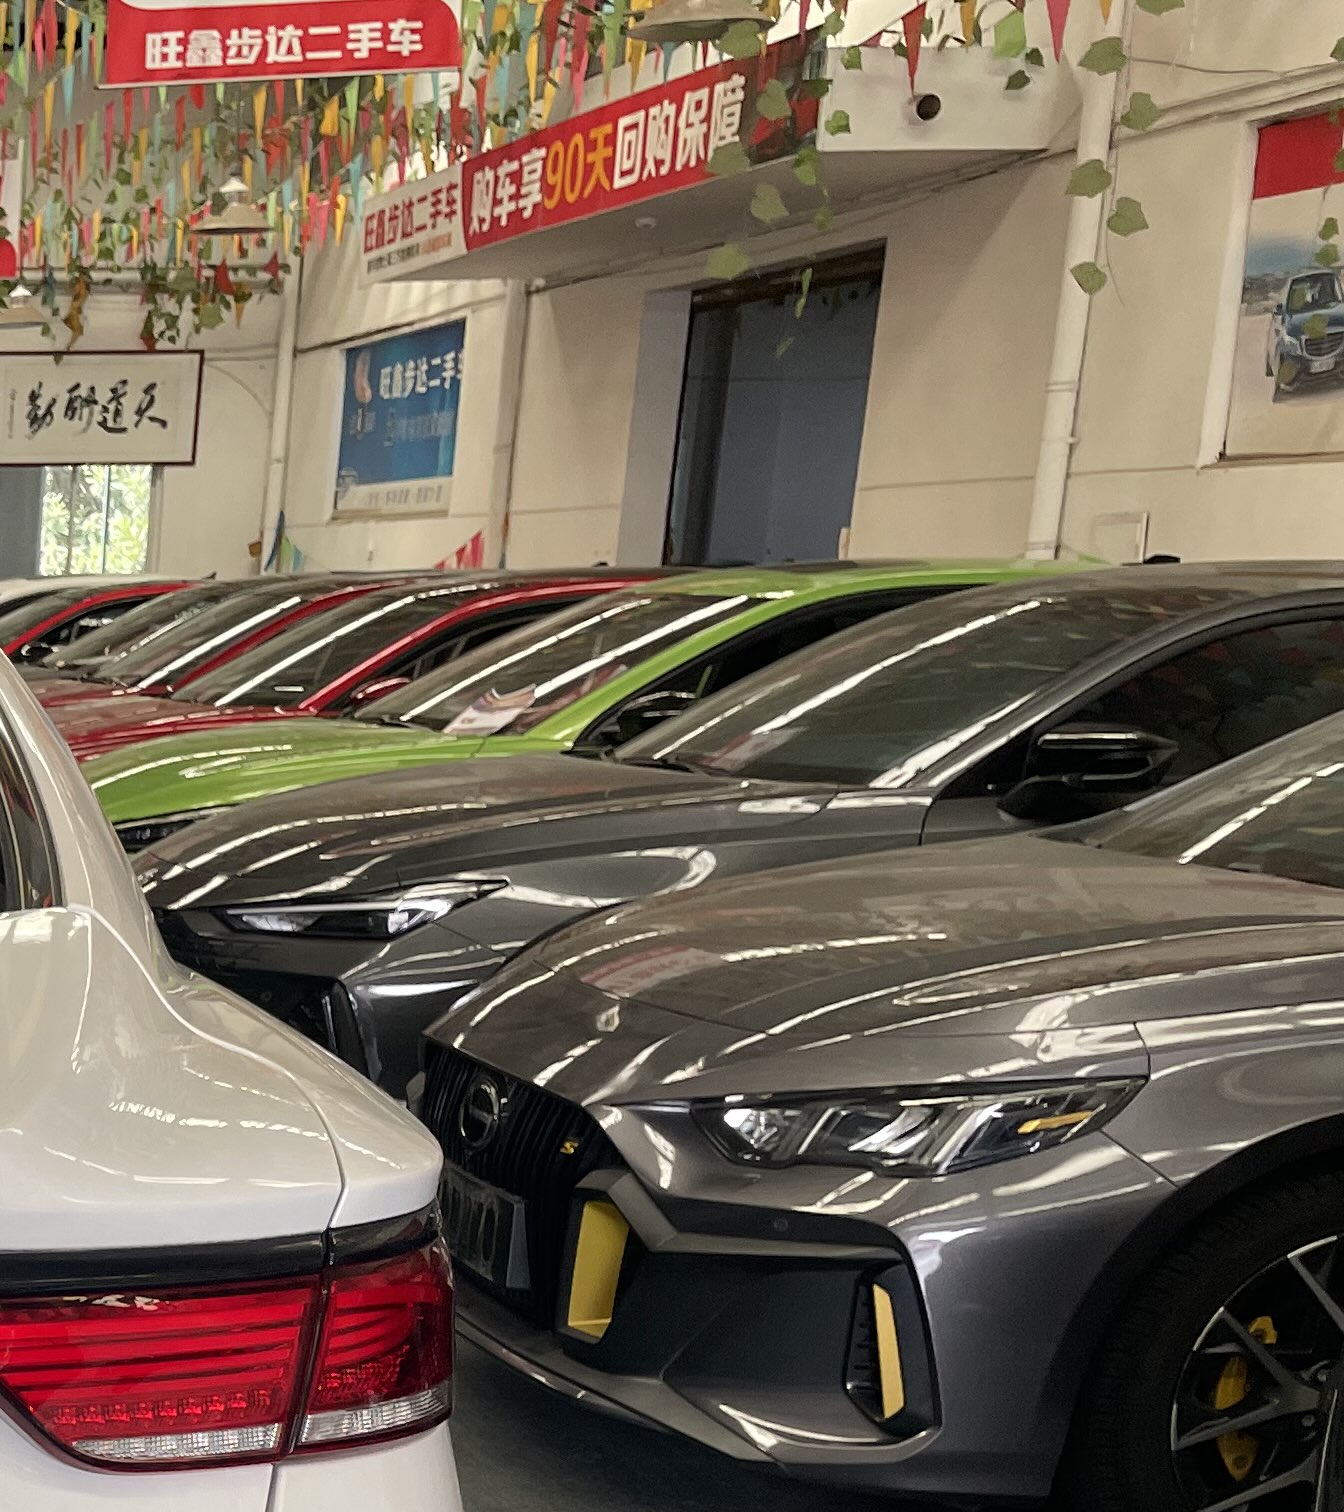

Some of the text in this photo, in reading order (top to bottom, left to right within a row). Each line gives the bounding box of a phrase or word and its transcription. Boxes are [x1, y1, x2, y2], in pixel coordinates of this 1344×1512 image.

[144, 18, 424, 70] 旺鑫步达二手车
[468, 72, 747, 236] 购车享90天回购保障
[363, 180, 459, 254] 旺鑫步达二手车
